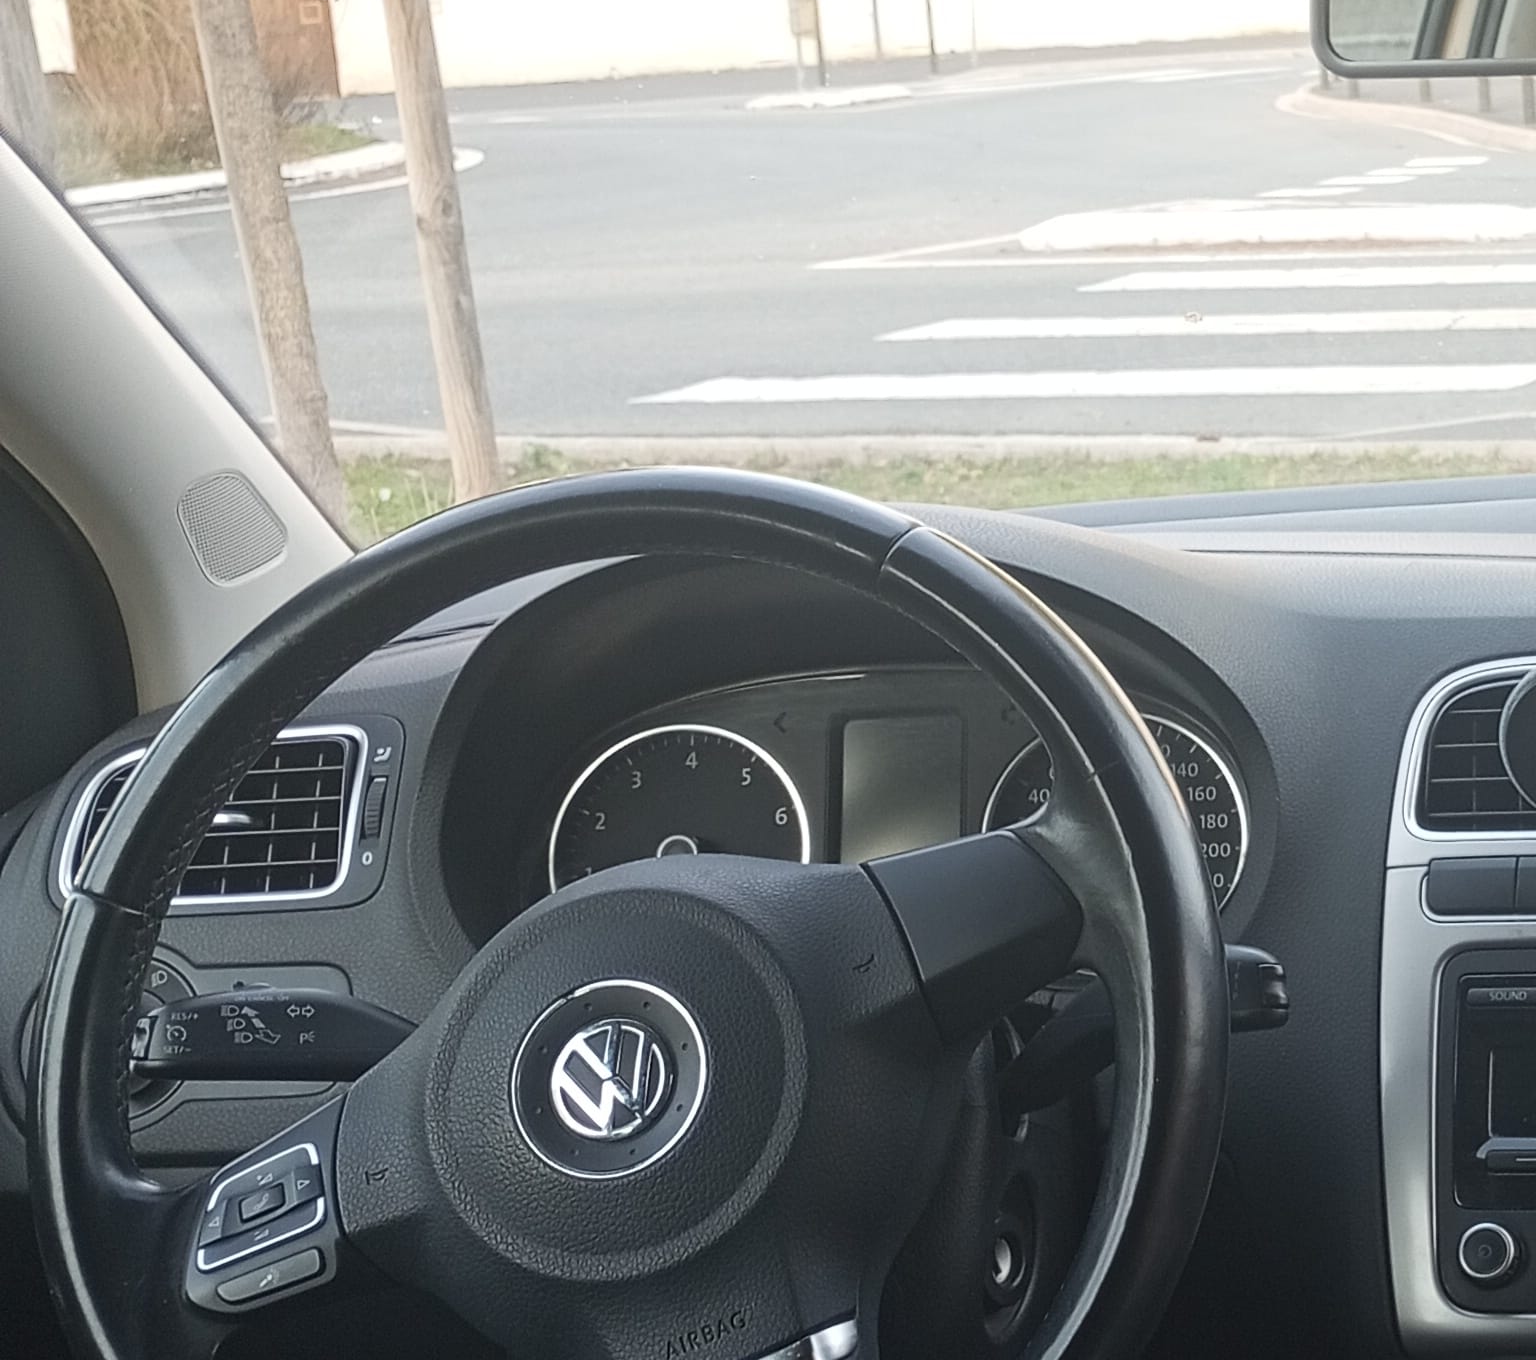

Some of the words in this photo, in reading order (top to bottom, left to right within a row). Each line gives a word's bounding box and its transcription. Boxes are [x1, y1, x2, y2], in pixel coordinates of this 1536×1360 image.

[685, 751, 698, 769] 4
[631, 771, 642, 789] 3
[741, 768, 751, 786] 5
[1187, 786, 1217, 801] 160
[595, 812, 606, 830] 2
[775, 807, 788, 825] 6
[1200, 813, 1228, 829] 180
[1488, 990, 1528, 1001] SOUND
[666, 1309, 746, 1360] AIRBAG
